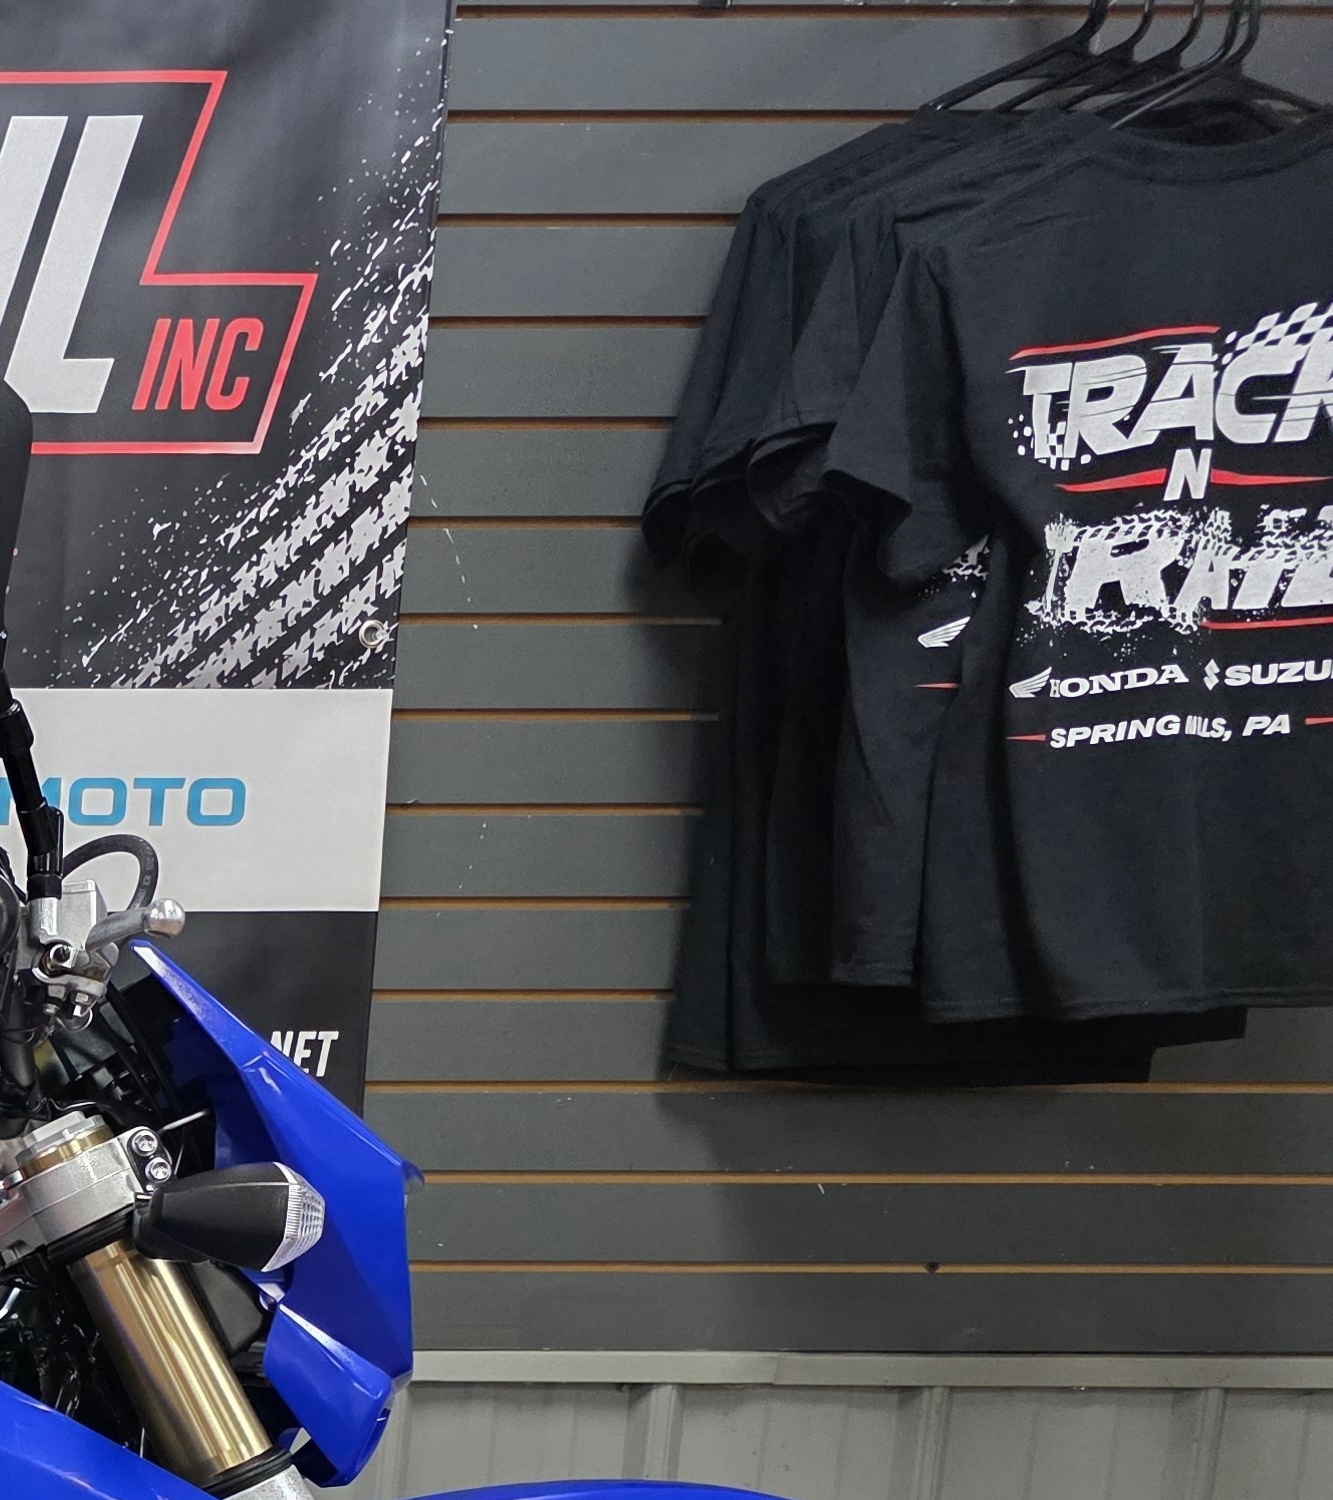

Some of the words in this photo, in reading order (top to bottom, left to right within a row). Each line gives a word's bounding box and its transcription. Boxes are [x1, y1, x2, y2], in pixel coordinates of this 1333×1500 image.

[131, 318, 264, 412] INC
[1163, 448, 1212, 501] N
[1050, 664, 1189, 698] HONDA
[1050, 714, 1181, 748] SPRING
[1242, 714, 1290, 736] PA
